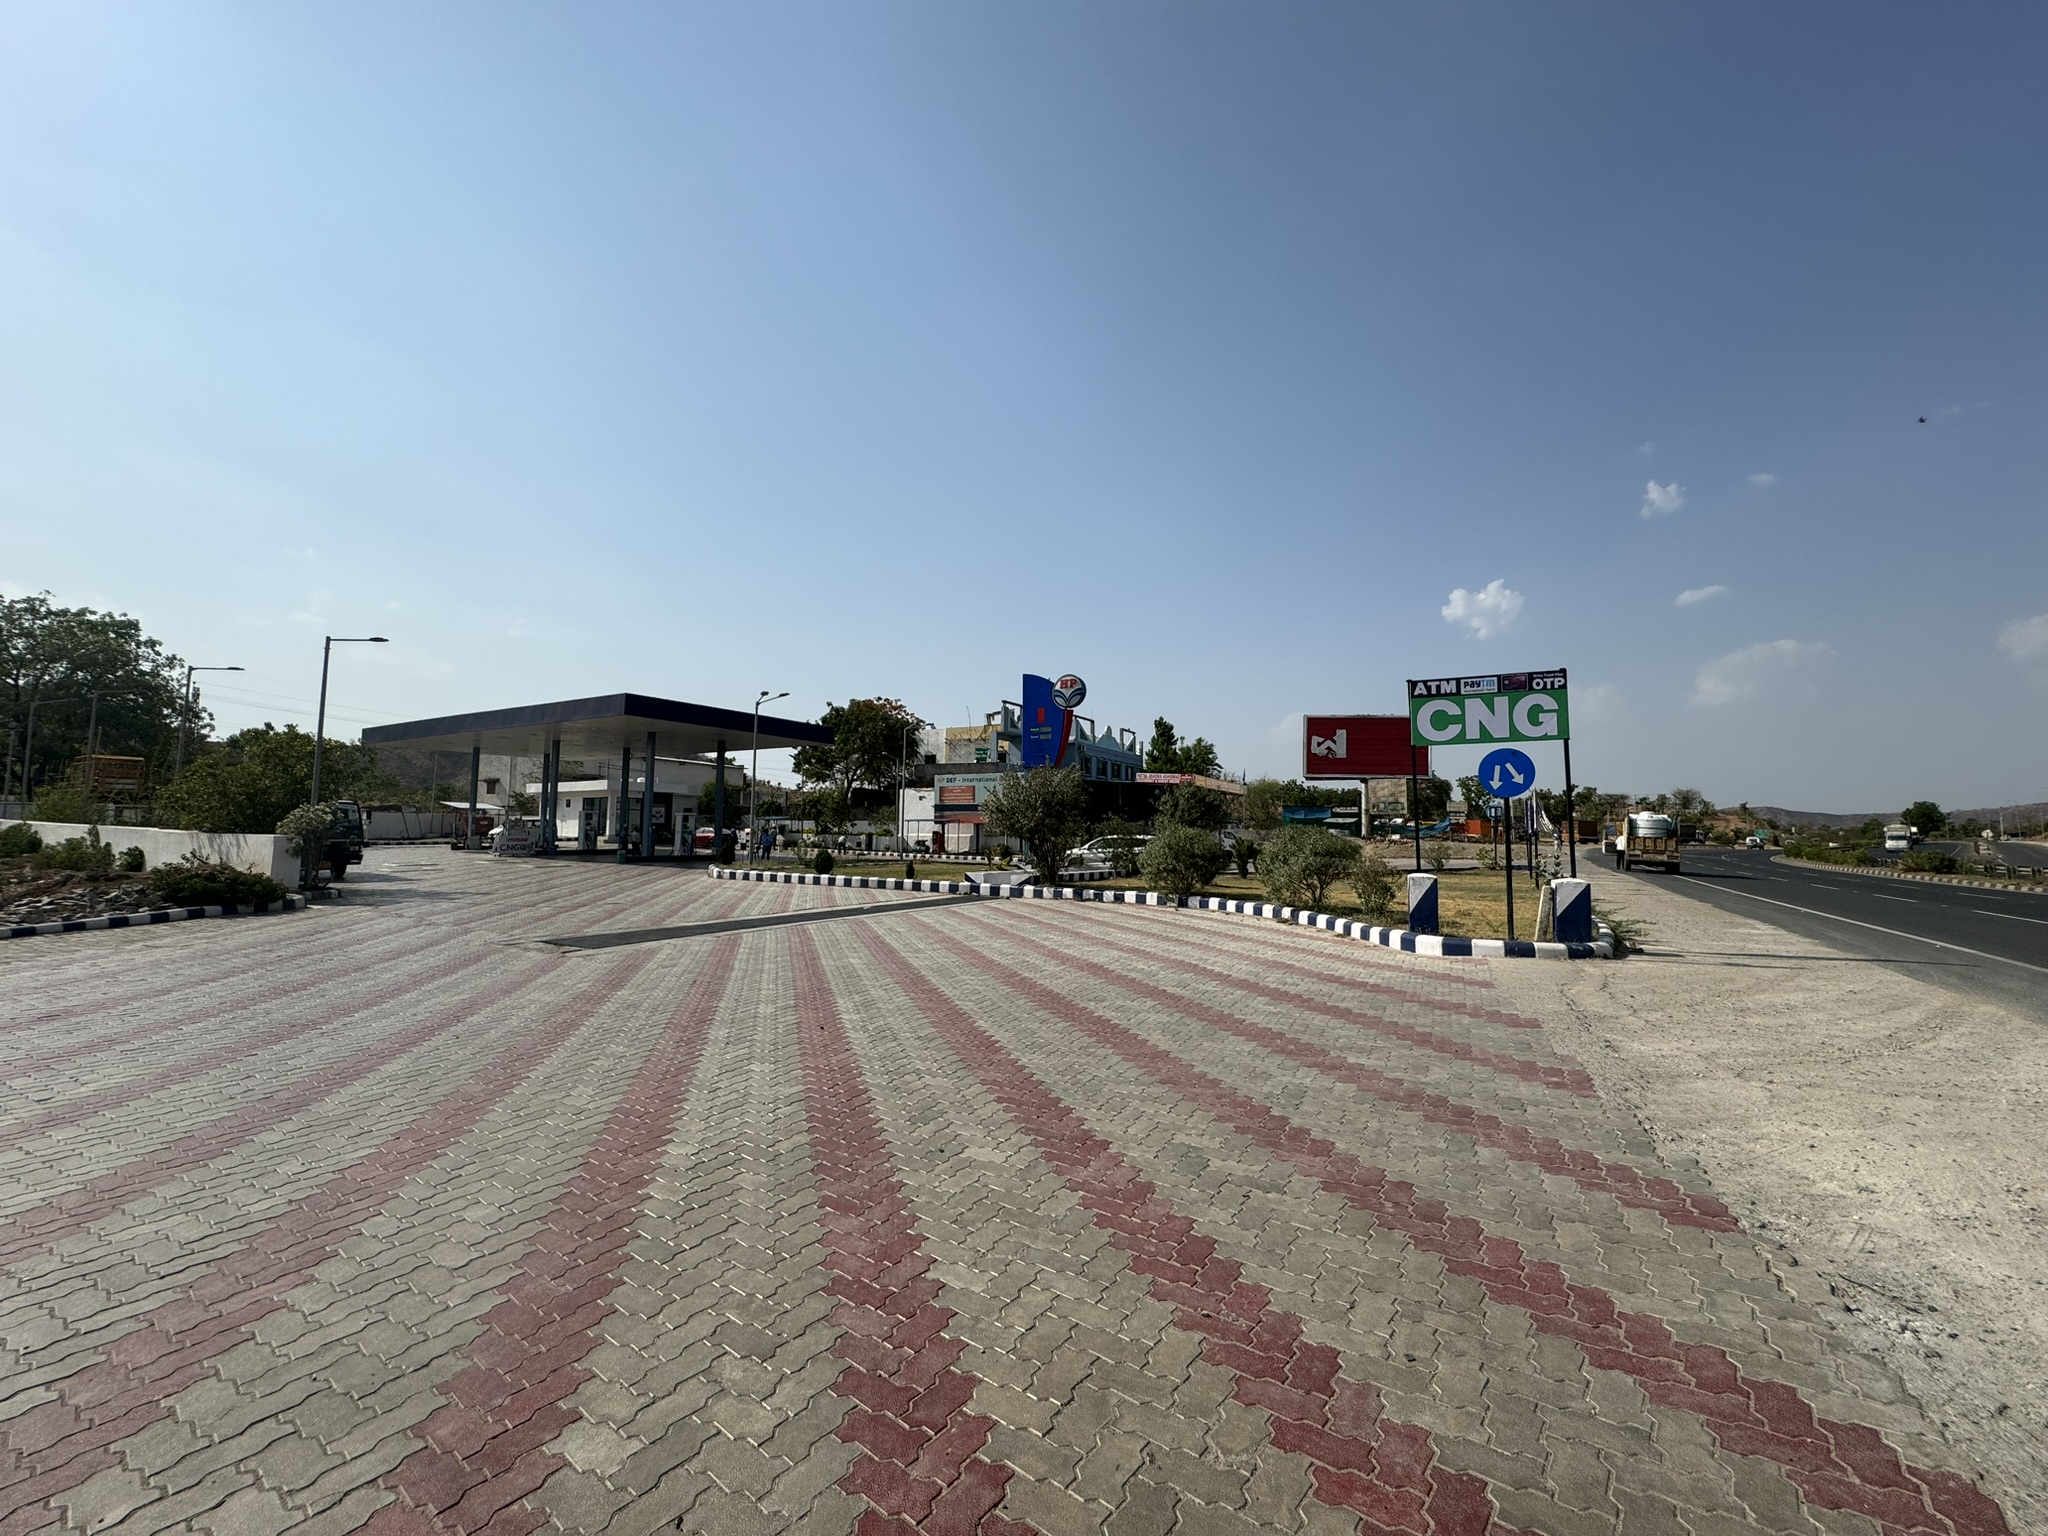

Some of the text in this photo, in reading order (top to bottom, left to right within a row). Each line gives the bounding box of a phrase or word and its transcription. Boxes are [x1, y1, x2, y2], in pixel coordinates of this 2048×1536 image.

[1059, 678, 1077, 689] HP
[1413, 680, 1457, 695] ATM
[1532, 677, 1565, 690] OTP
[1416, 693, 1559, 742] CNG
[499, 843, 520, 852] CNG
